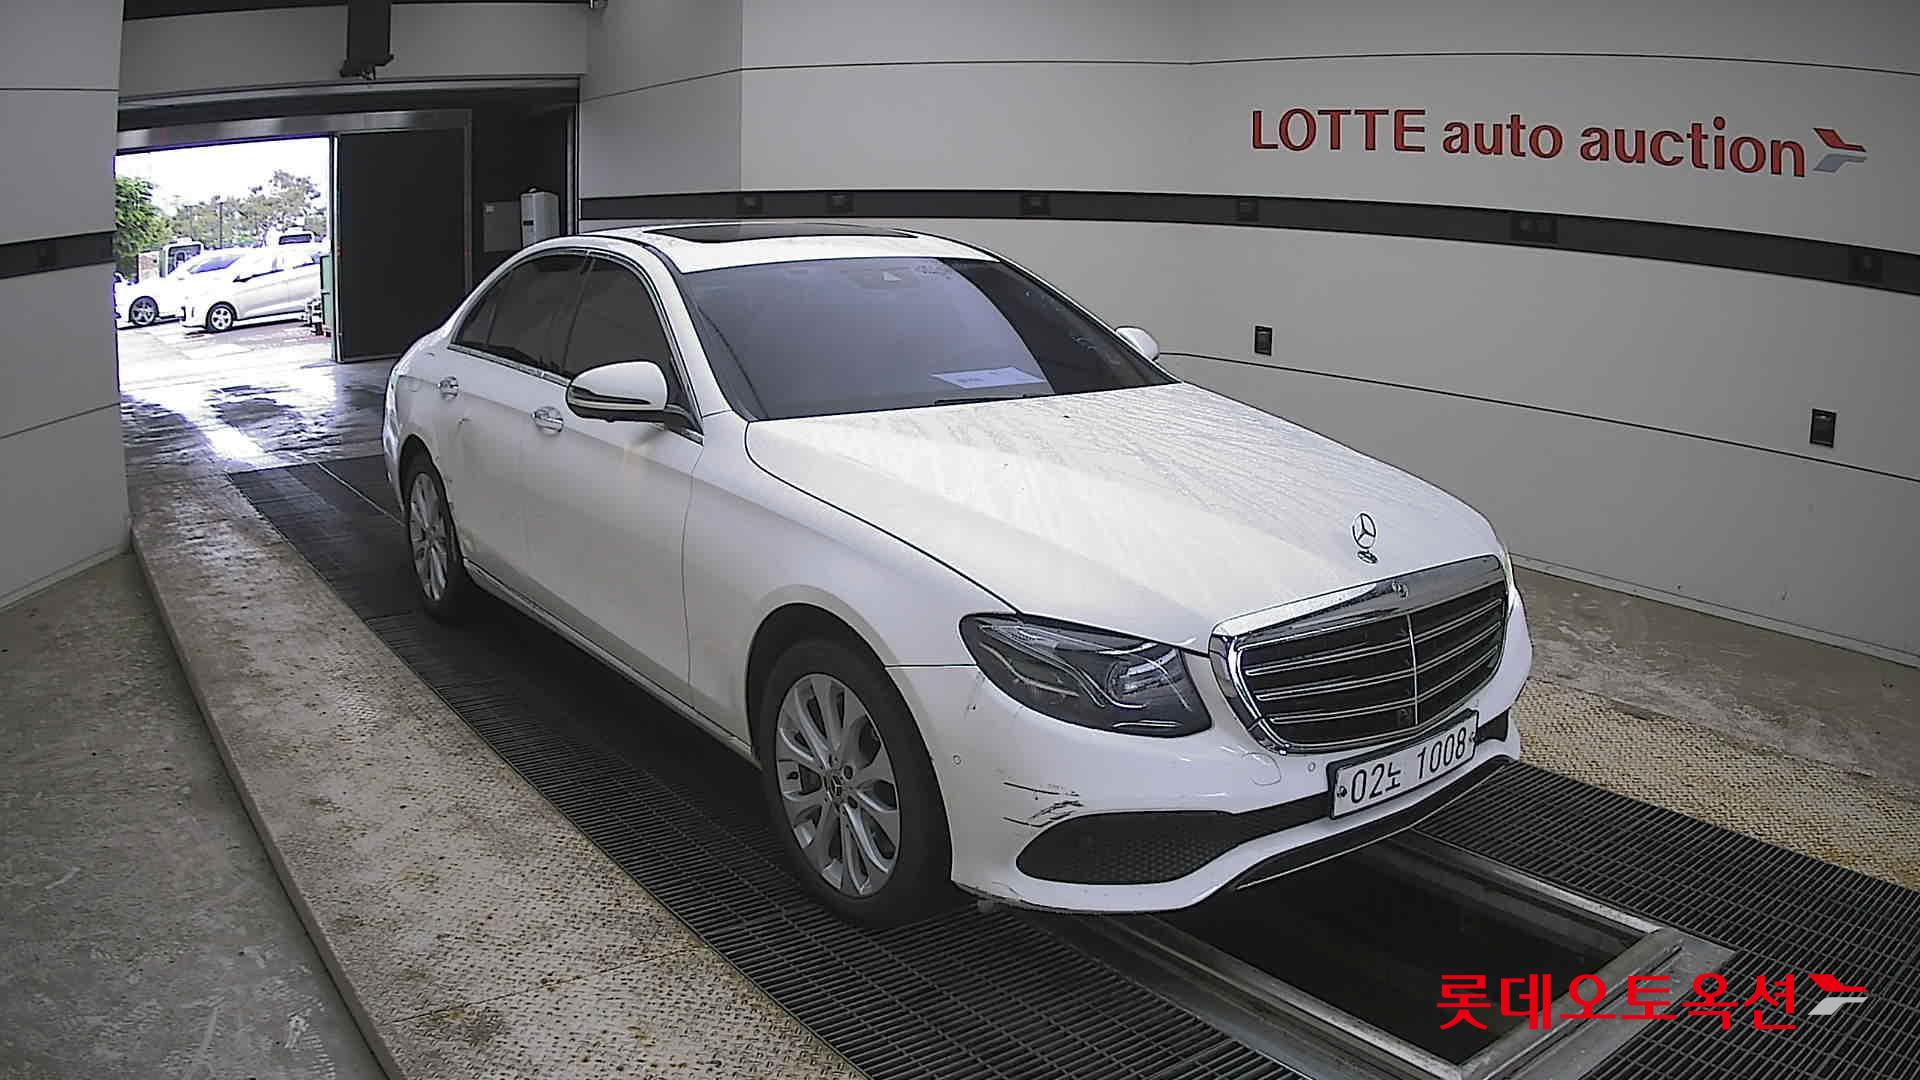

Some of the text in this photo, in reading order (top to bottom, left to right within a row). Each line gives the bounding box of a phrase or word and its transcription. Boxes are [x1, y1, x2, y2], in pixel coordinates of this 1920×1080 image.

[1252, 108, 1806, 177] LOTTE auto auction
[1351, 727, 1466, 803] 02노 1008
